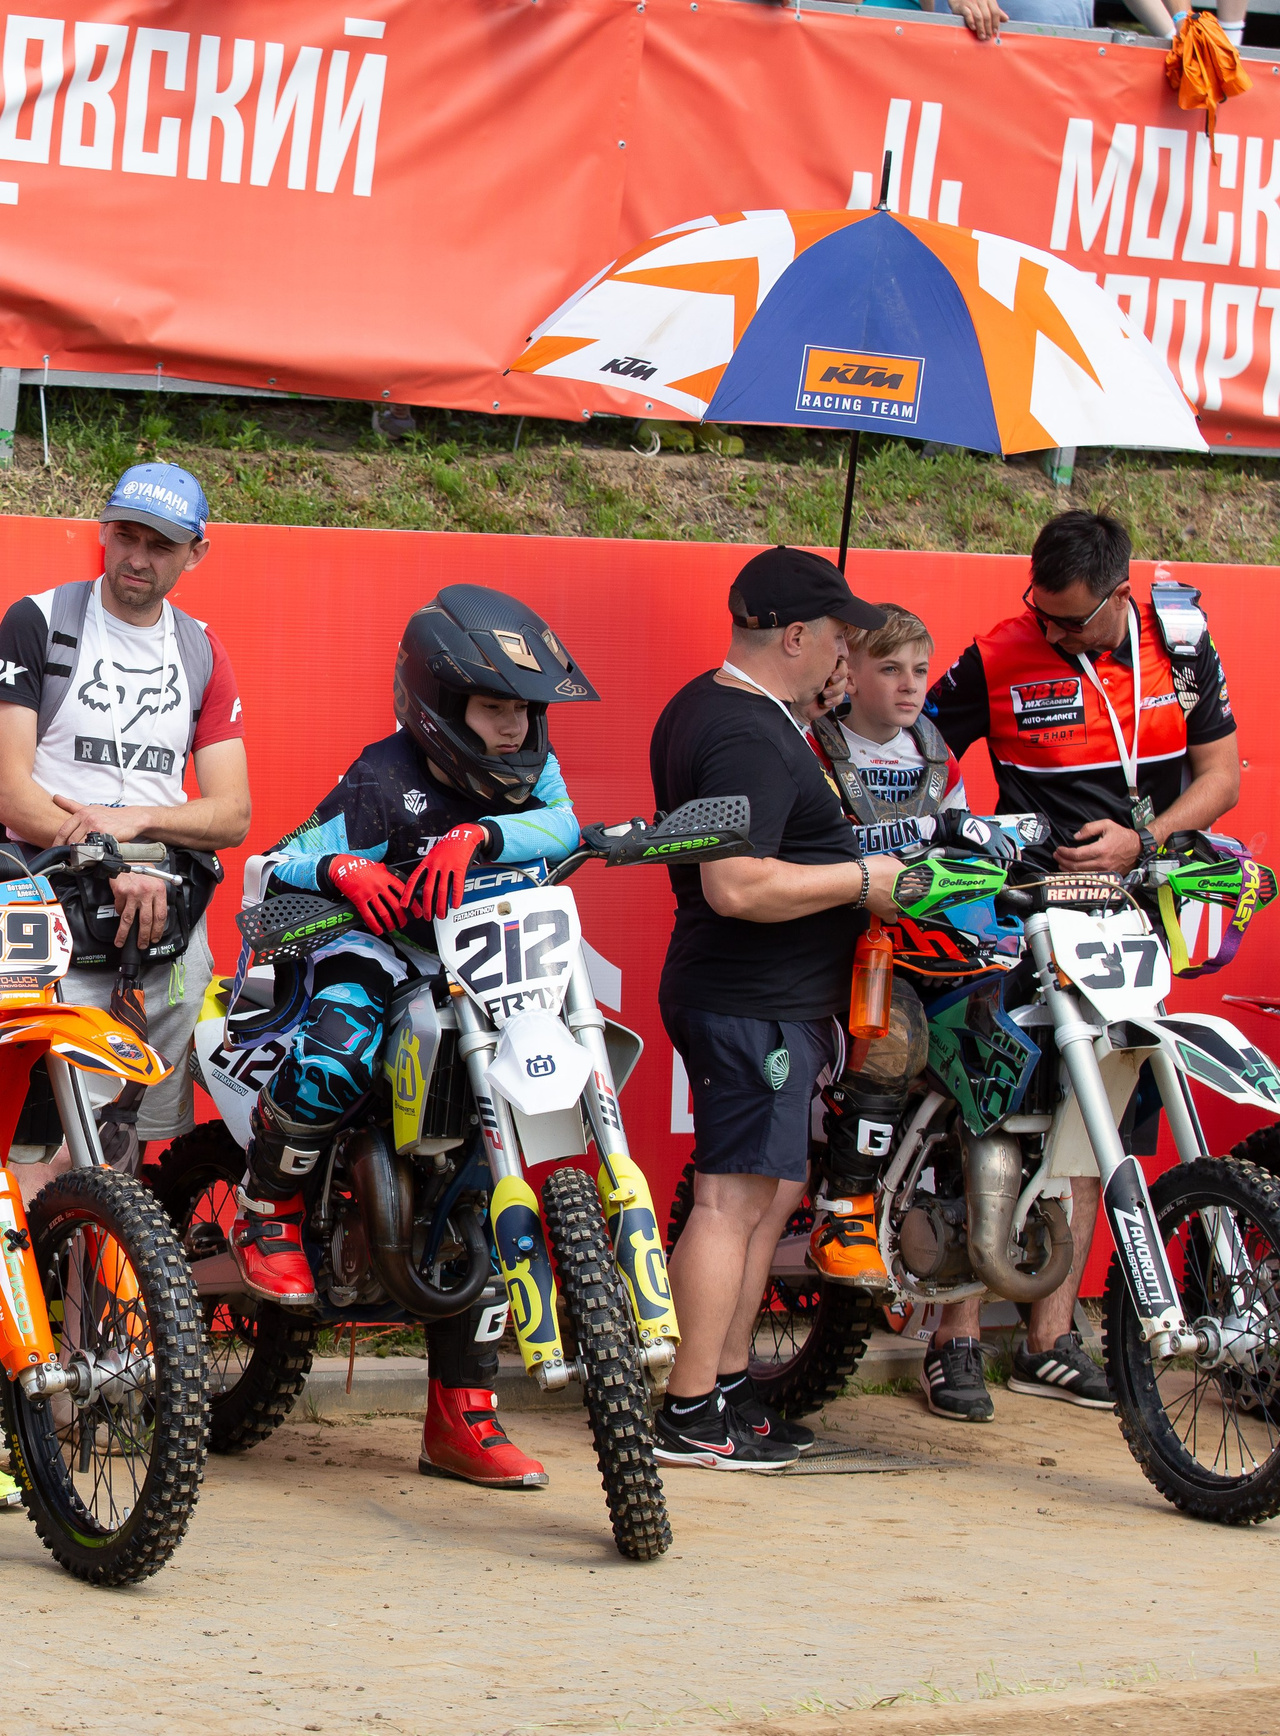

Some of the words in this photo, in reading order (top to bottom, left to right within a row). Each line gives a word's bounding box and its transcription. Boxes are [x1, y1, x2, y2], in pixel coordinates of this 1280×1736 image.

[599, 356, 659, 381] KTM
[818, 362, 905, 390] KTM
[801, 394, 862, 412] RACING
[871, 400, 915, 418] TEAM
[124, 493, 183, 517] RACING
[137, 481, 188, 514] YAMAHA
[938, 878, 987, 888] Polisport
[1046, 888, 1123, 901] RENTHAL
[1231, 859, 1261, 932] OAKLEY
[454, 908, 572, 995] 212
[1075, 939, 1161, 990] 37
[1112, 1206, 1171, 1304] ZAVOROTTI
[1123, 1243, 1153, 1306] SUSPENSION
[10, 1433, 34, 1492] MAXXIS
